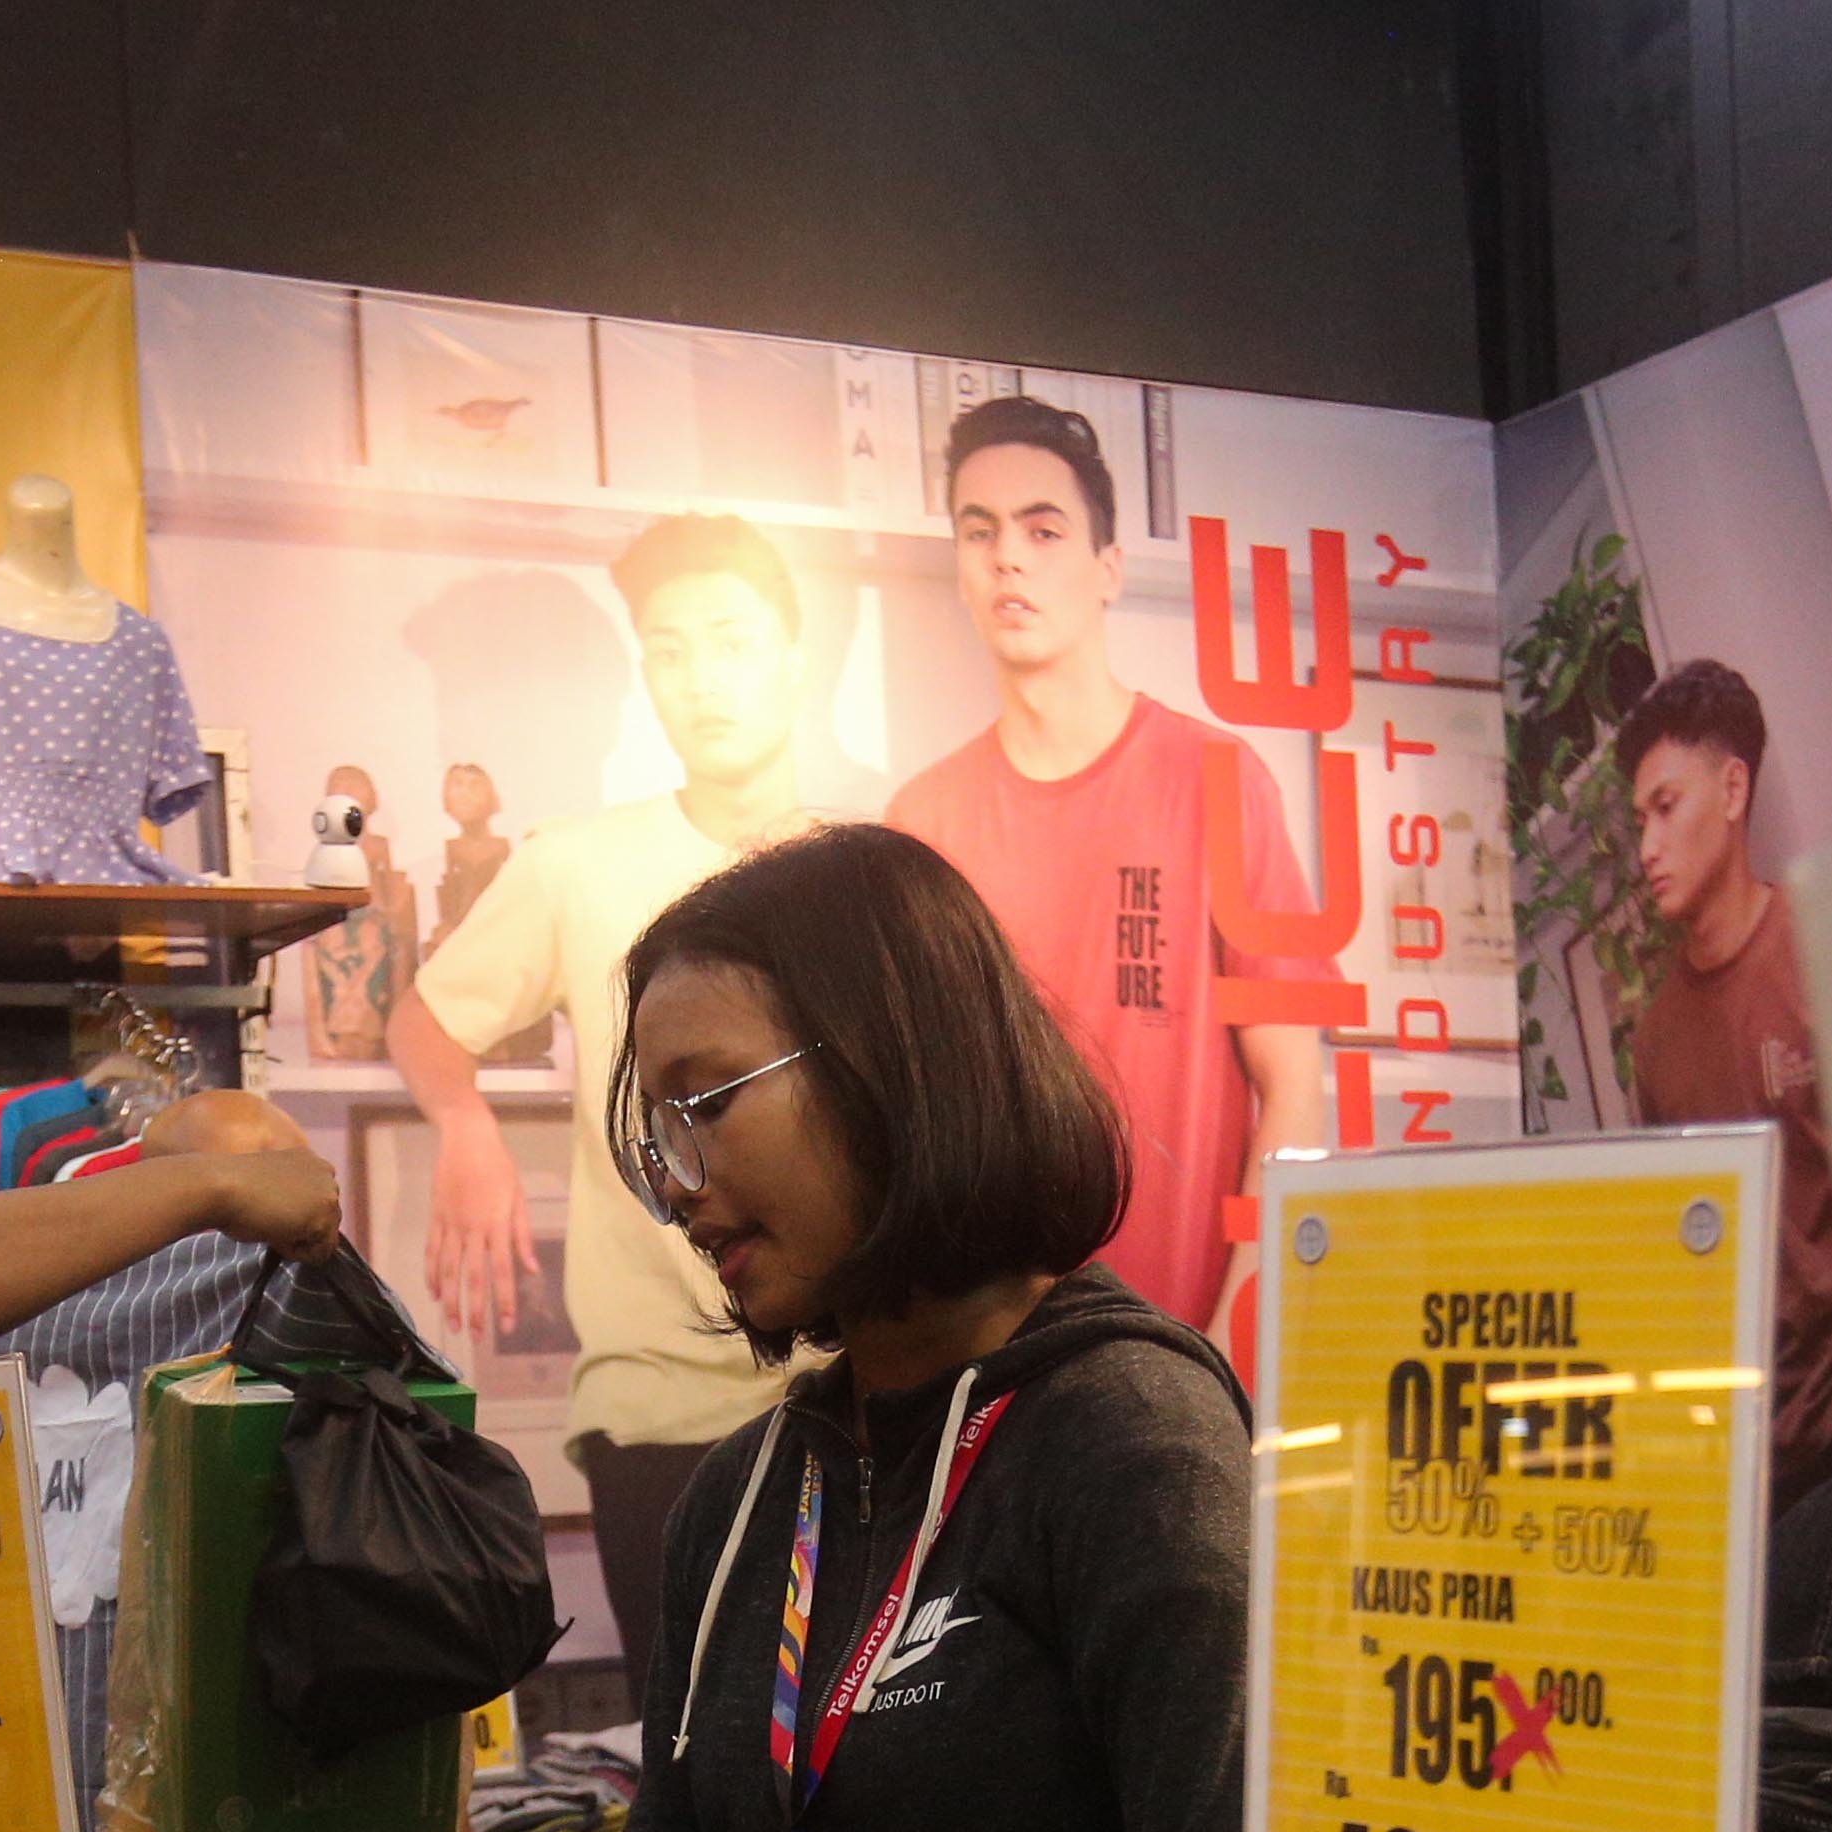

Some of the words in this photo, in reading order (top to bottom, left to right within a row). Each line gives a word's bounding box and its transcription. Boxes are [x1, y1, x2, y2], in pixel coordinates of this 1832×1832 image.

[1375, 533, 1452, 1144] NDUSTRY
[1118, 867, 1161, 912] THE
[1116, 914, 1169, 960] FUT-
[1116, 963, 1164, 1010] URE
[1422, 1290, 1578, 1349] SPECIAL
[1386, 1358, 1616, 1481] OFFER
[1386, 1457, 1500, 1540] 50%
[1553, 1506, 1657, 1578] 50%
[1351, 1565, 1434, 1618] KAUS
[1440, 1572, 1516, 1624] PRIA
[826, 1593, 901, 1720] Telkomsel
[871, 1689, 904, 1713] JUST
[903, 1684, 926, 1706] DO
[929, 1681, 946, 1700] IT
